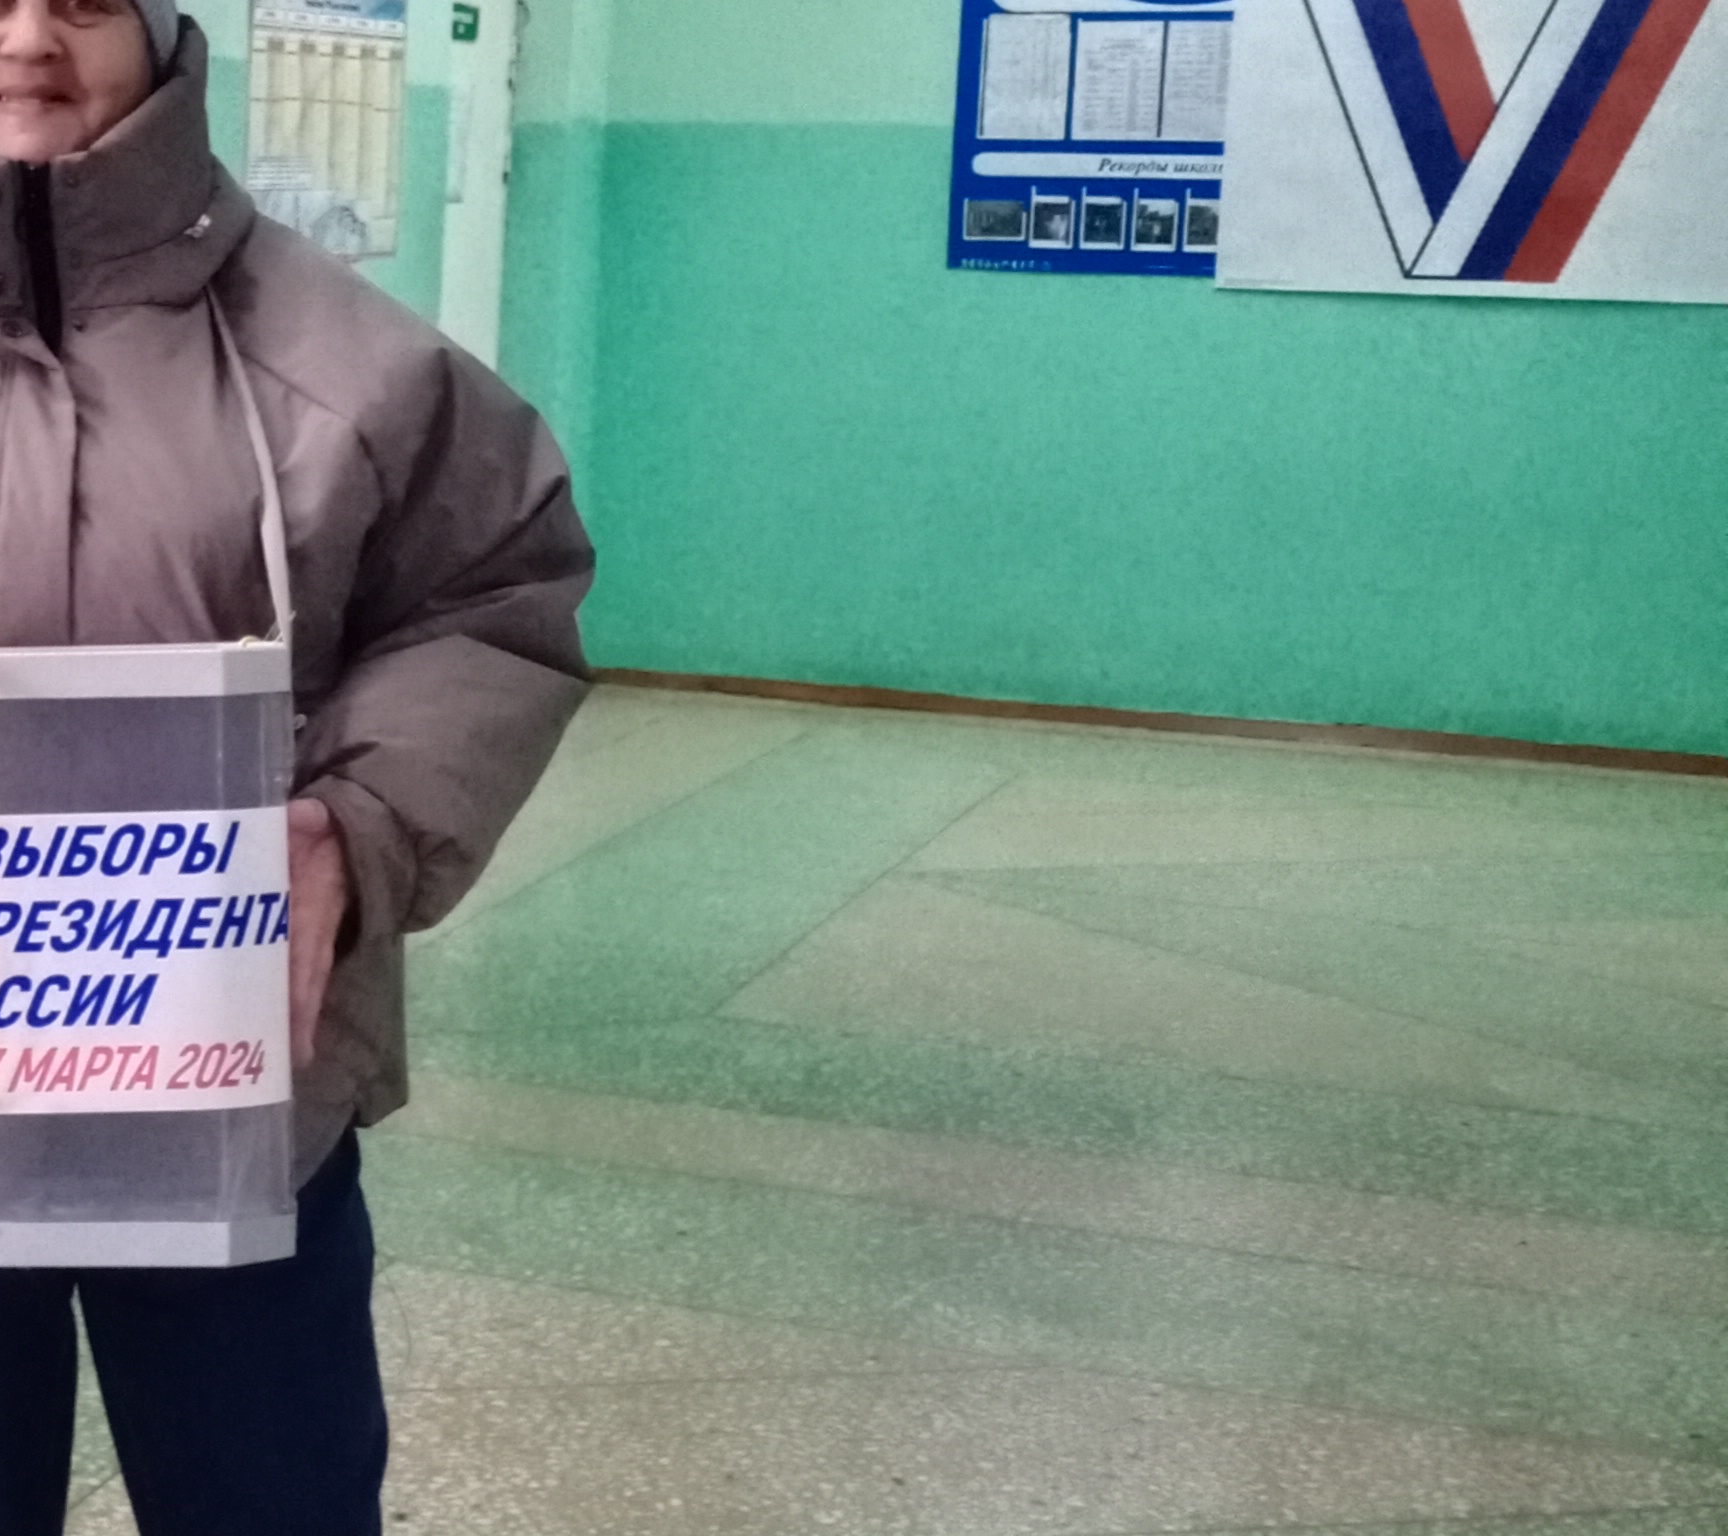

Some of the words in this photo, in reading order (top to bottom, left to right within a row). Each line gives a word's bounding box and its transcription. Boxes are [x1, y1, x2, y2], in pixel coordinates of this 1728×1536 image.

[1098, 158, 1169, 175] Рекорды
[7, 1044, 161, 1093] МАРТА
[165, 1038, 266, 1091] 2024
